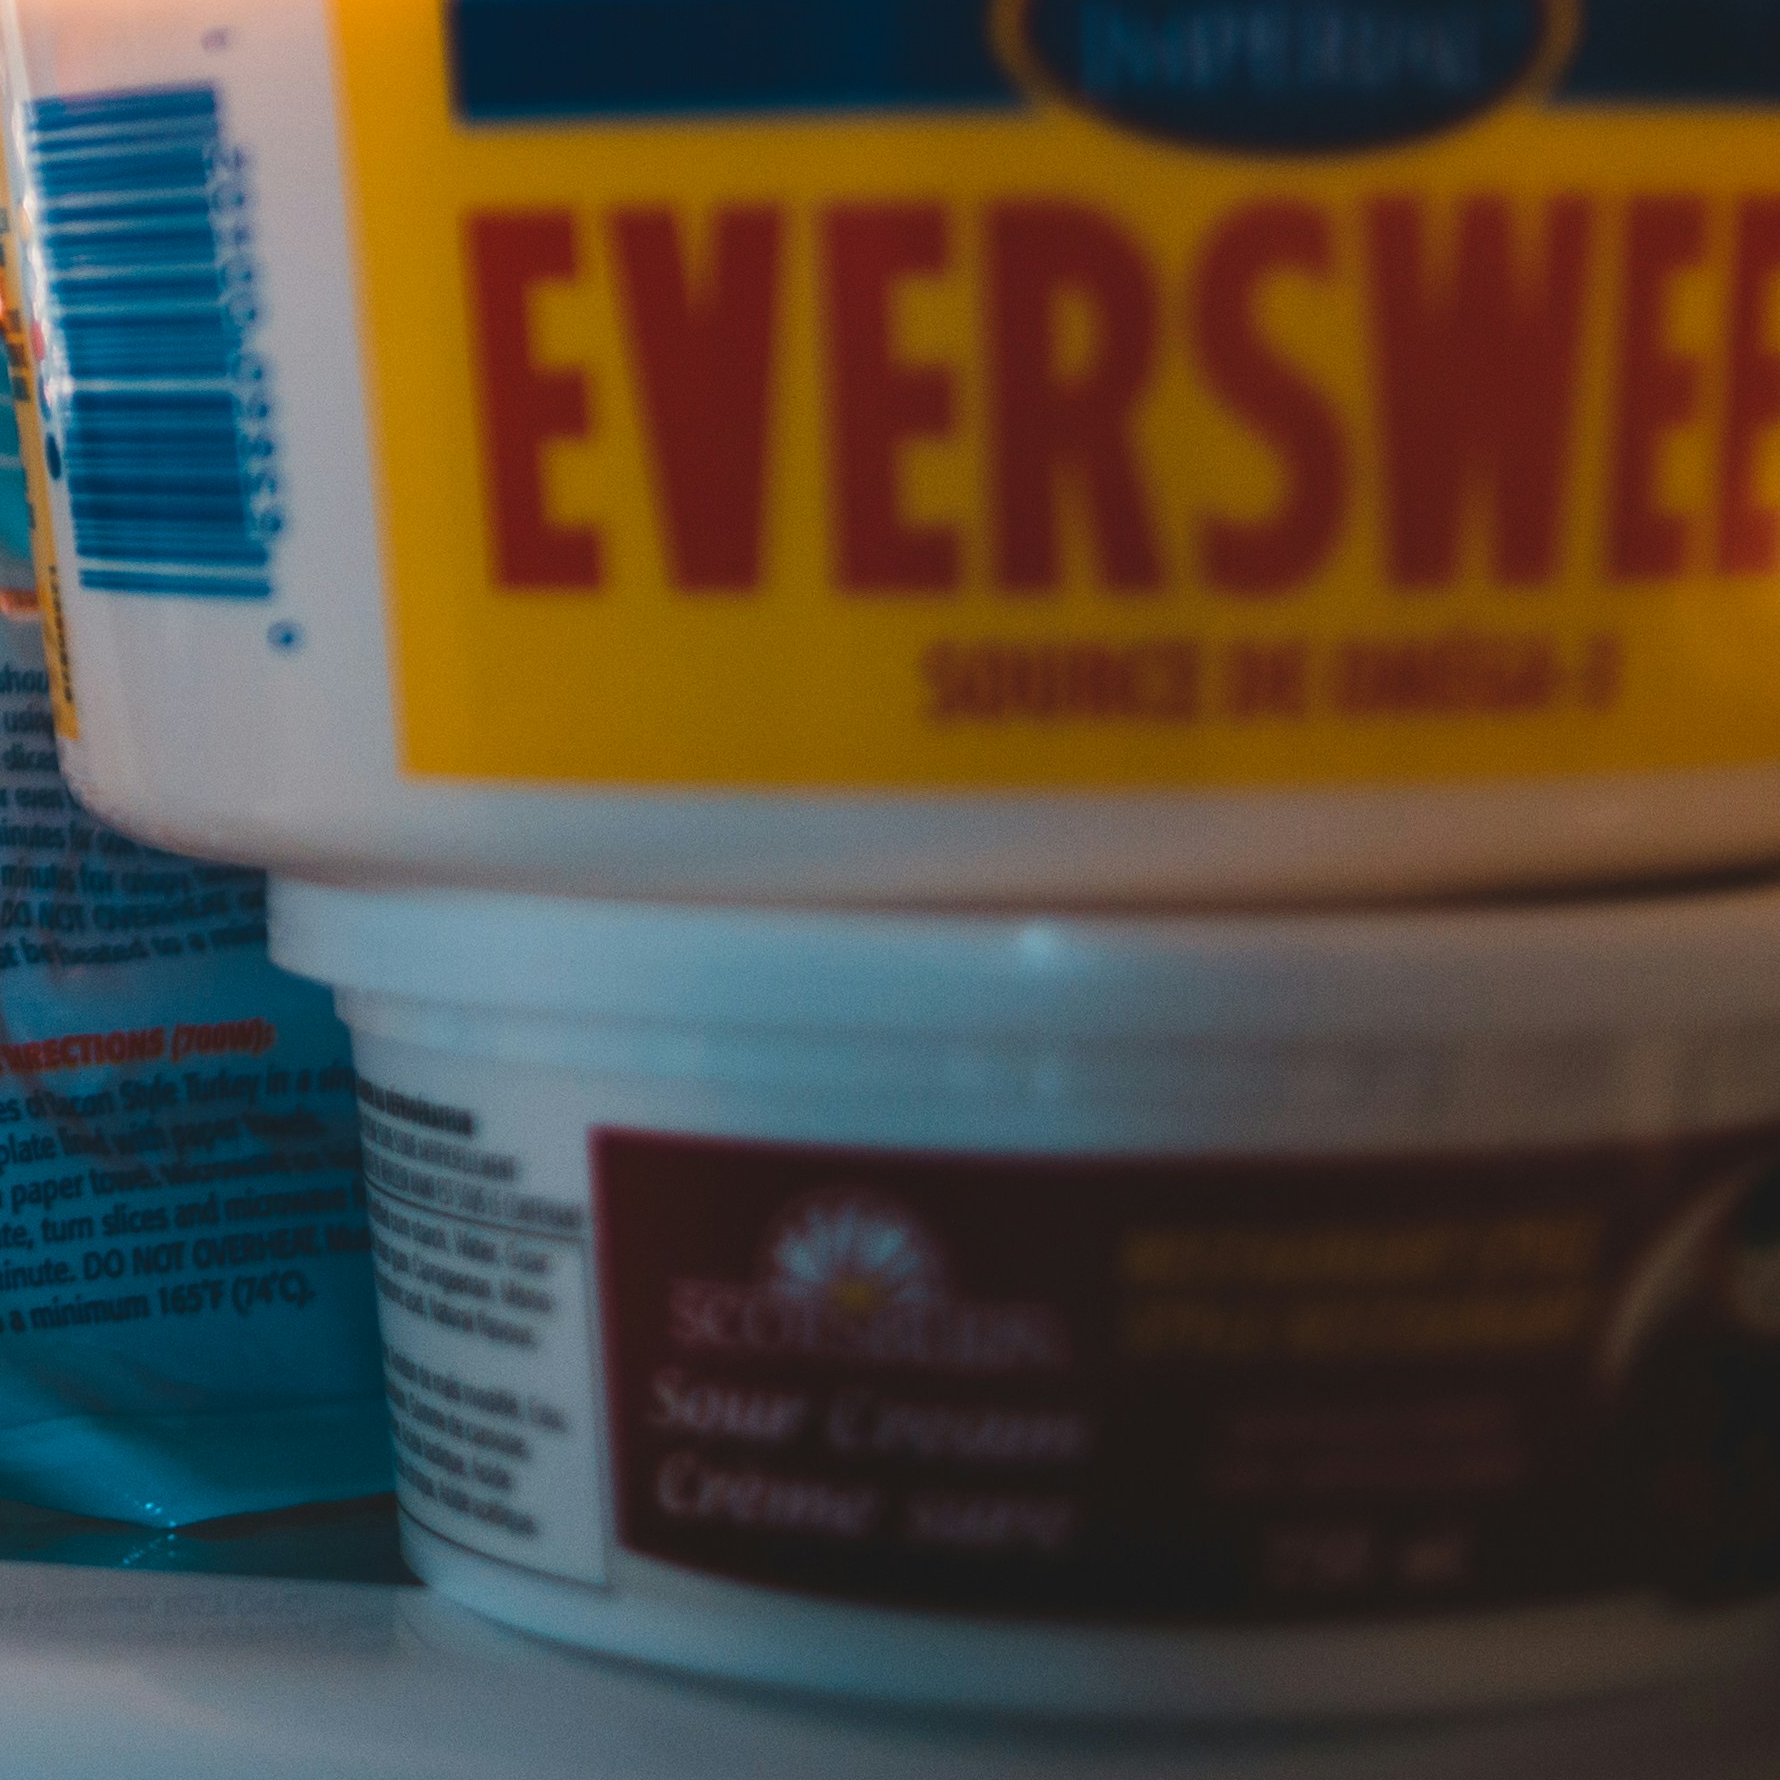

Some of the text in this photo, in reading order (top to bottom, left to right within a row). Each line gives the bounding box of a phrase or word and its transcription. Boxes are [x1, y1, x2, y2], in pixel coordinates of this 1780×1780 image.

[460, 188, 1780, 600] EVERSWEE
[10, 1172, 85, 1216] paper
[40, 1213, 96, 1243] turn
[100, 1203, 171, 1238] slices
[173, 1192, 220, 1227] and
[82, 1247, 126, 1281] DO
[131, 1240, 187, 1278] NOT
[8, 1308, 28, 1334] a
[29, 1290, 151, 1330] minimum
